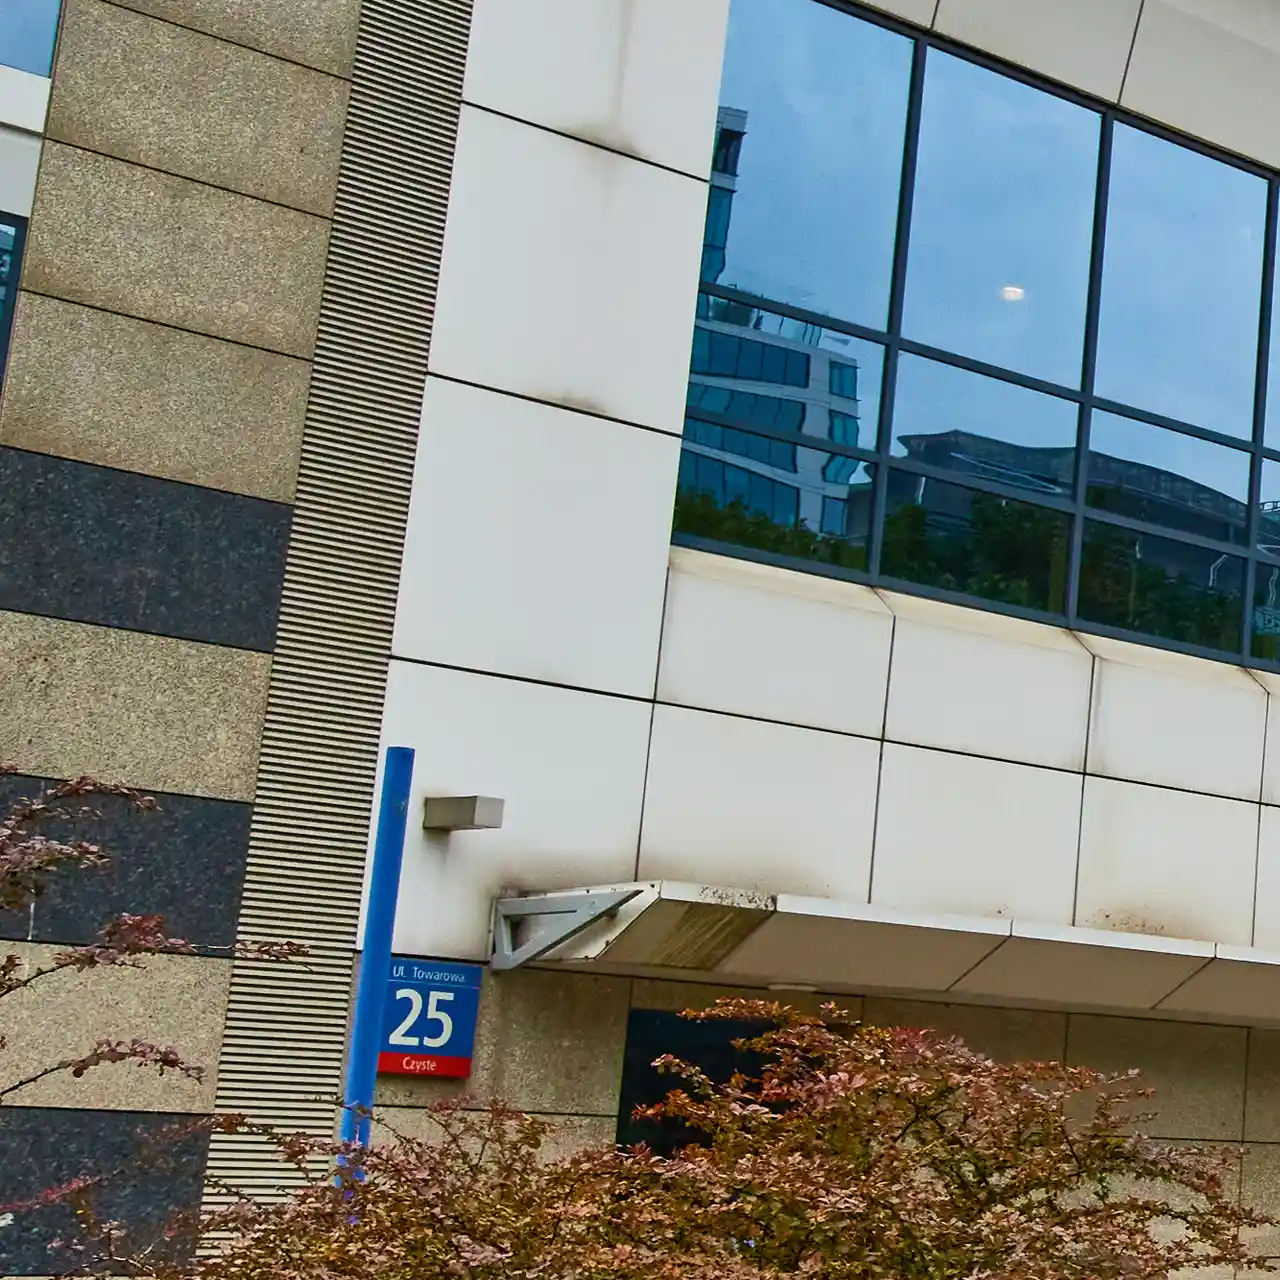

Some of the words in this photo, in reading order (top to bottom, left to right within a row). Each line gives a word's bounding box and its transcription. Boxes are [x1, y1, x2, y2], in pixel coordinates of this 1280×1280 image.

[412, 966, 467, 983] Towarowa
[388, 988, 455, 1049] 25
[402, 1056, 437, 1073] Czyste
